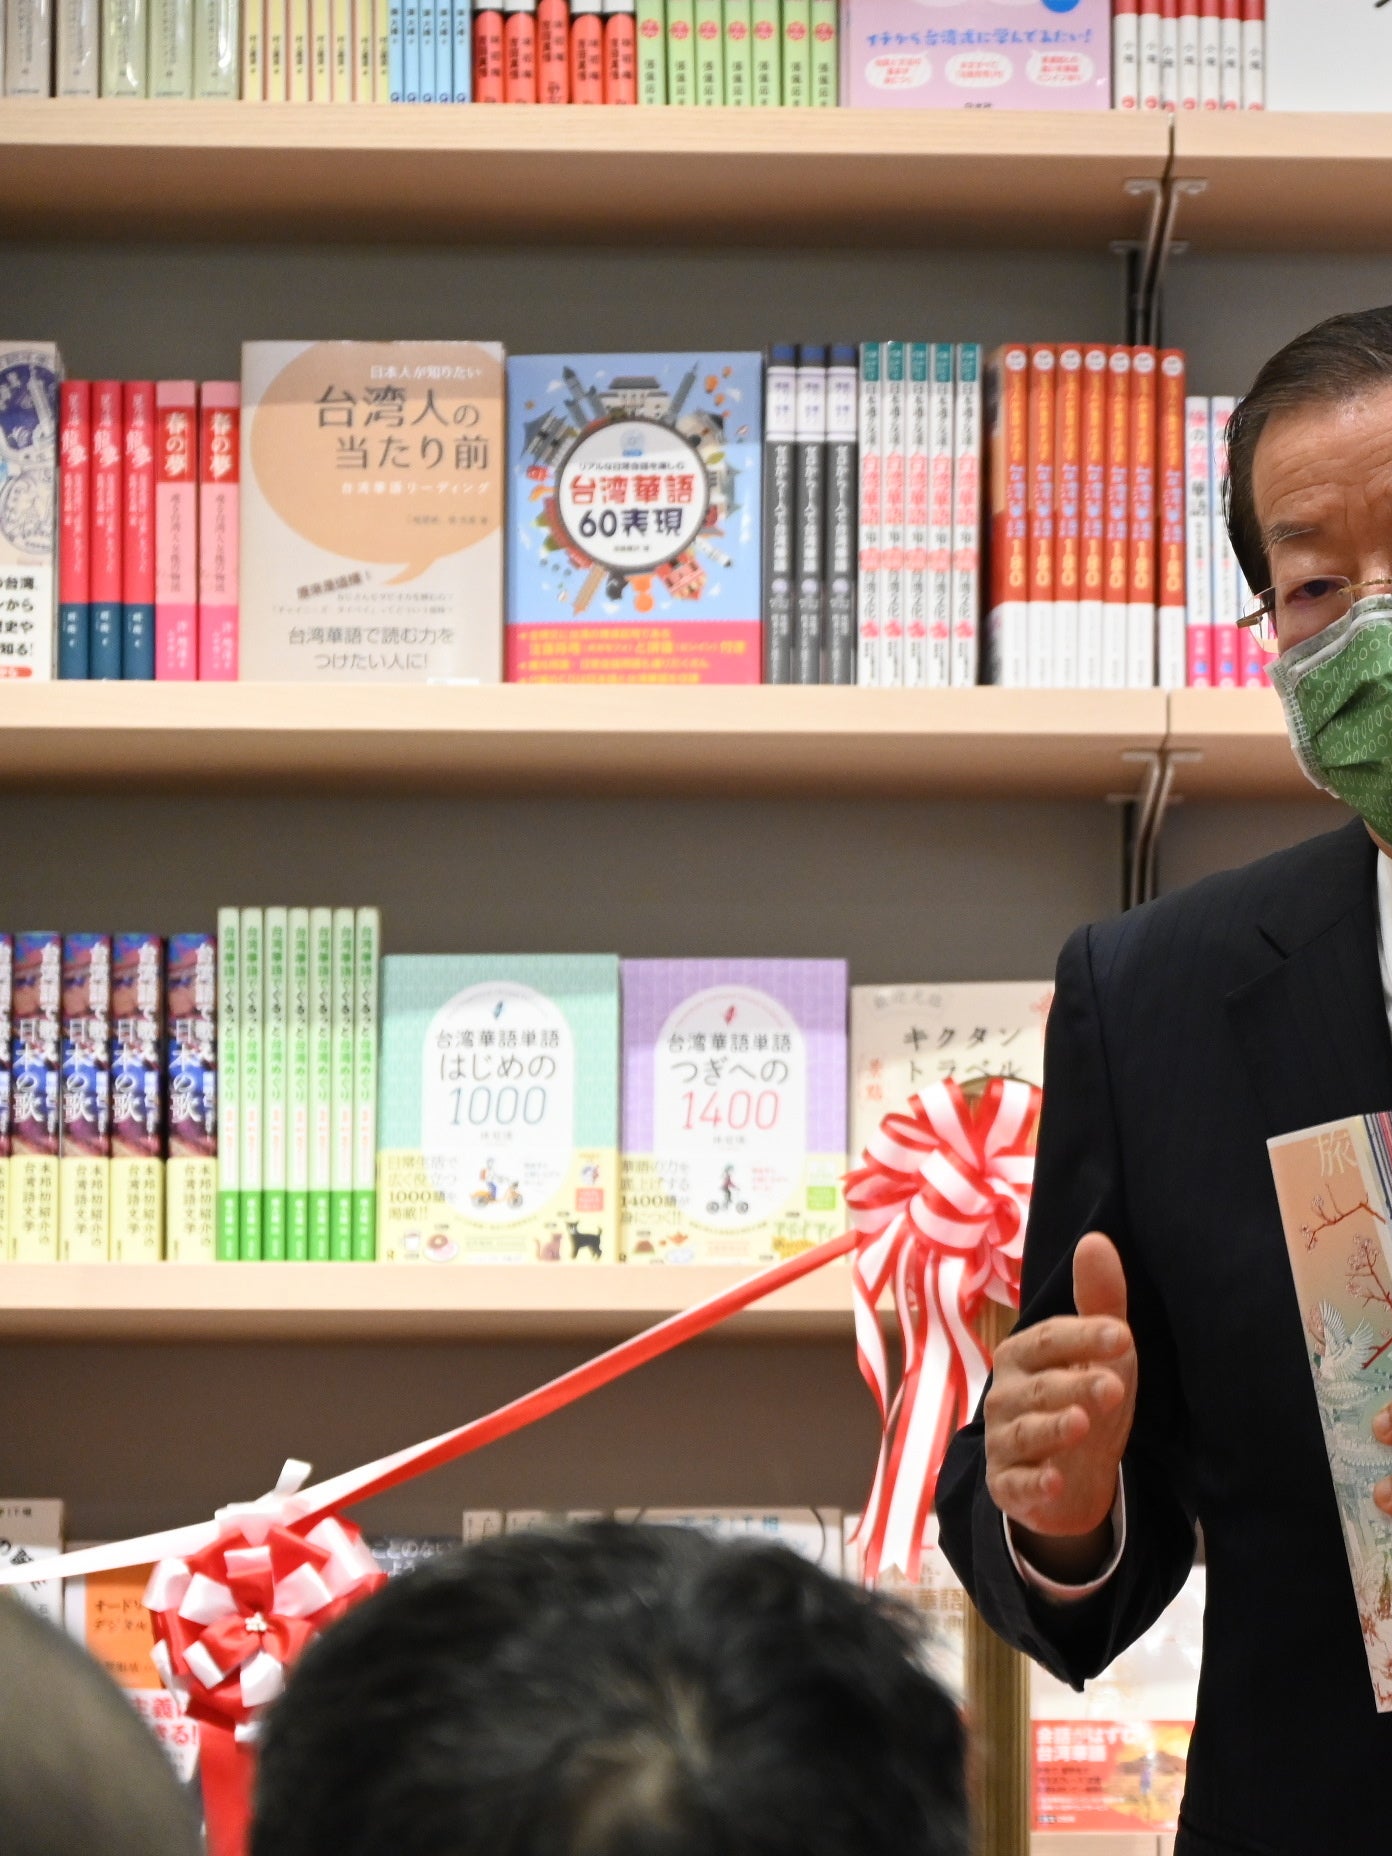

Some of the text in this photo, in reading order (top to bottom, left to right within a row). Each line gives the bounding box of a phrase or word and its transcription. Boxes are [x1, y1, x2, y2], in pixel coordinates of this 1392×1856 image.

[315, 384, 481, 429] 台湾人の
[165, 411, 189, 477] 春の夢
[210, 411, 234, 477] 春の夢
[336, 434, 490, 470] 当たり前
[570, 473, 695, 505] 台湾華語
[579, 507, 683, 538] 60表現
[0, 576, 35, 591] 台湾
[288, 627, 456, 646] 台湾華語で読む力を
[436, 1029, 560, 1048] 台湾華語単語
[667, 1031, 792, 1052] 台湾華語単語
[903, 1026, 1021, 1051] キクタン
[440, 1053, 557, 1082] はじめの
[670, 1058, 790, 1087] つぎへの
[449, 1085, 548, 1126] 1000
[682, 1090, 782, 1130] 1400
[1314, 1130, 1358, 1178] 旅
